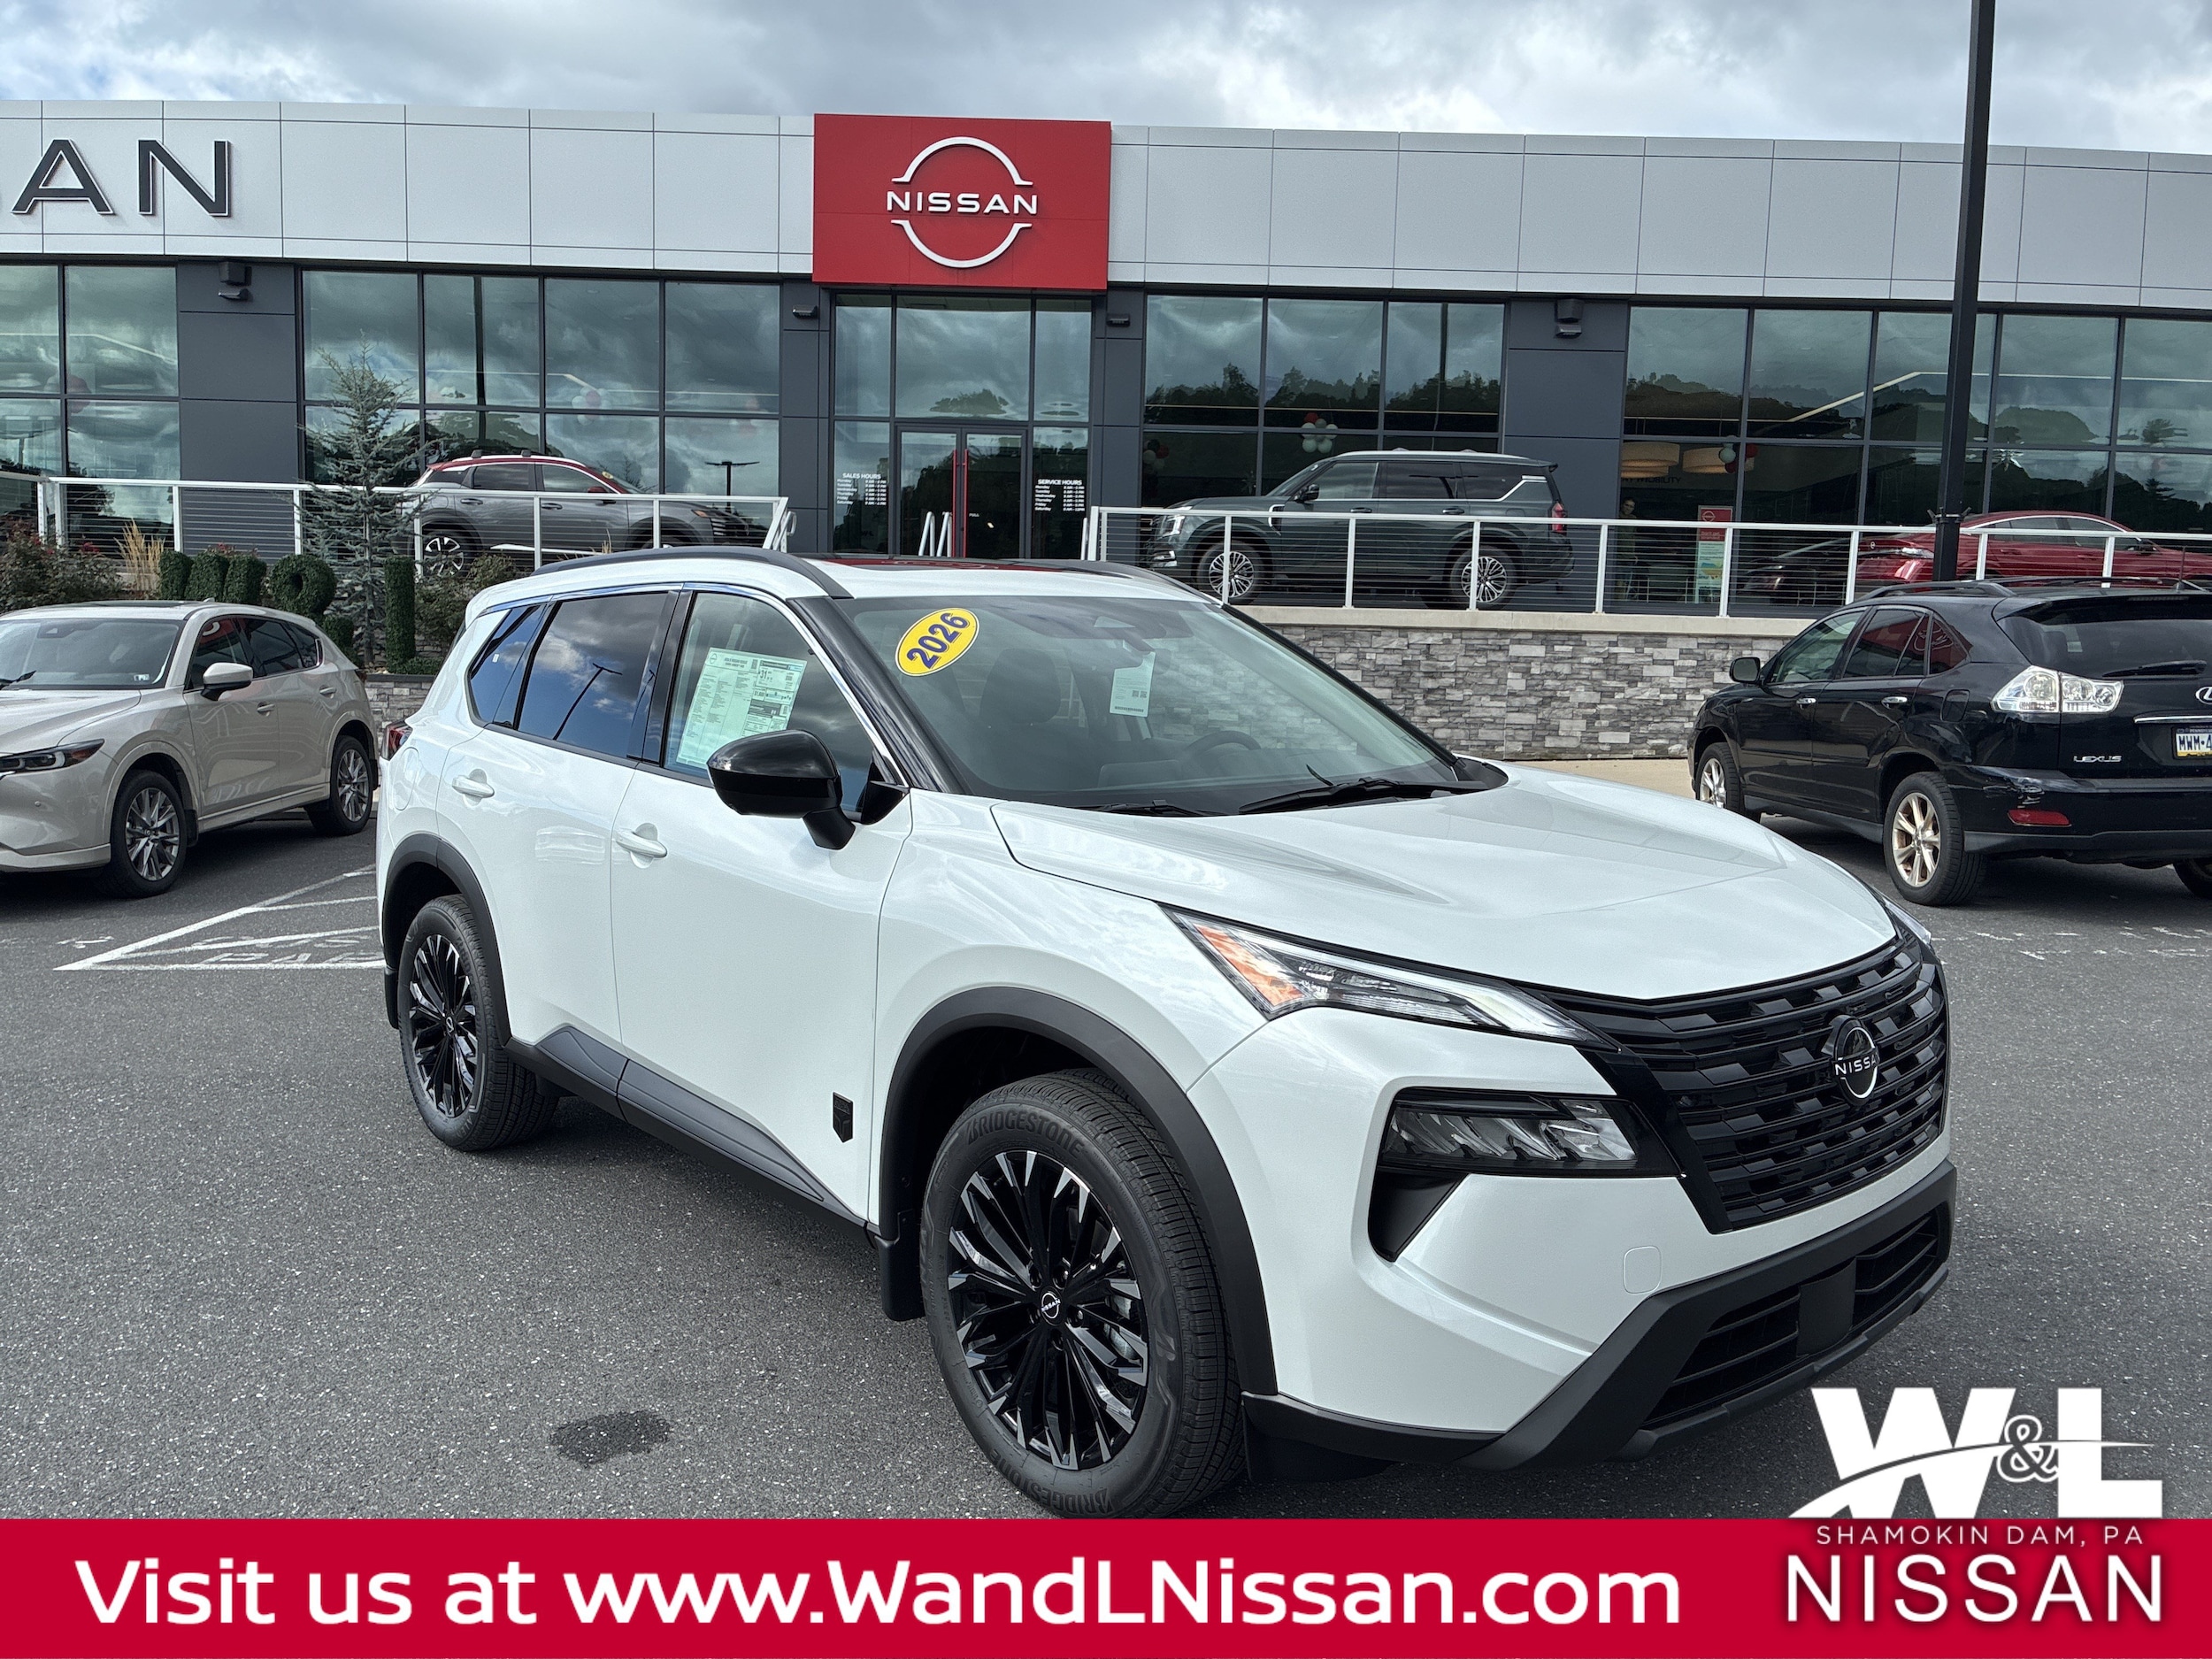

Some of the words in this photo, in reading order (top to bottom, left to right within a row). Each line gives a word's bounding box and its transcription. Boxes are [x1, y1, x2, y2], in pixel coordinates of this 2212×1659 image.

[887, 191, 1038, 215] NISSAN
[906, 611, 971, 670] 2026
[967, 1110, 1087, 1159] BRIDGESTONE
